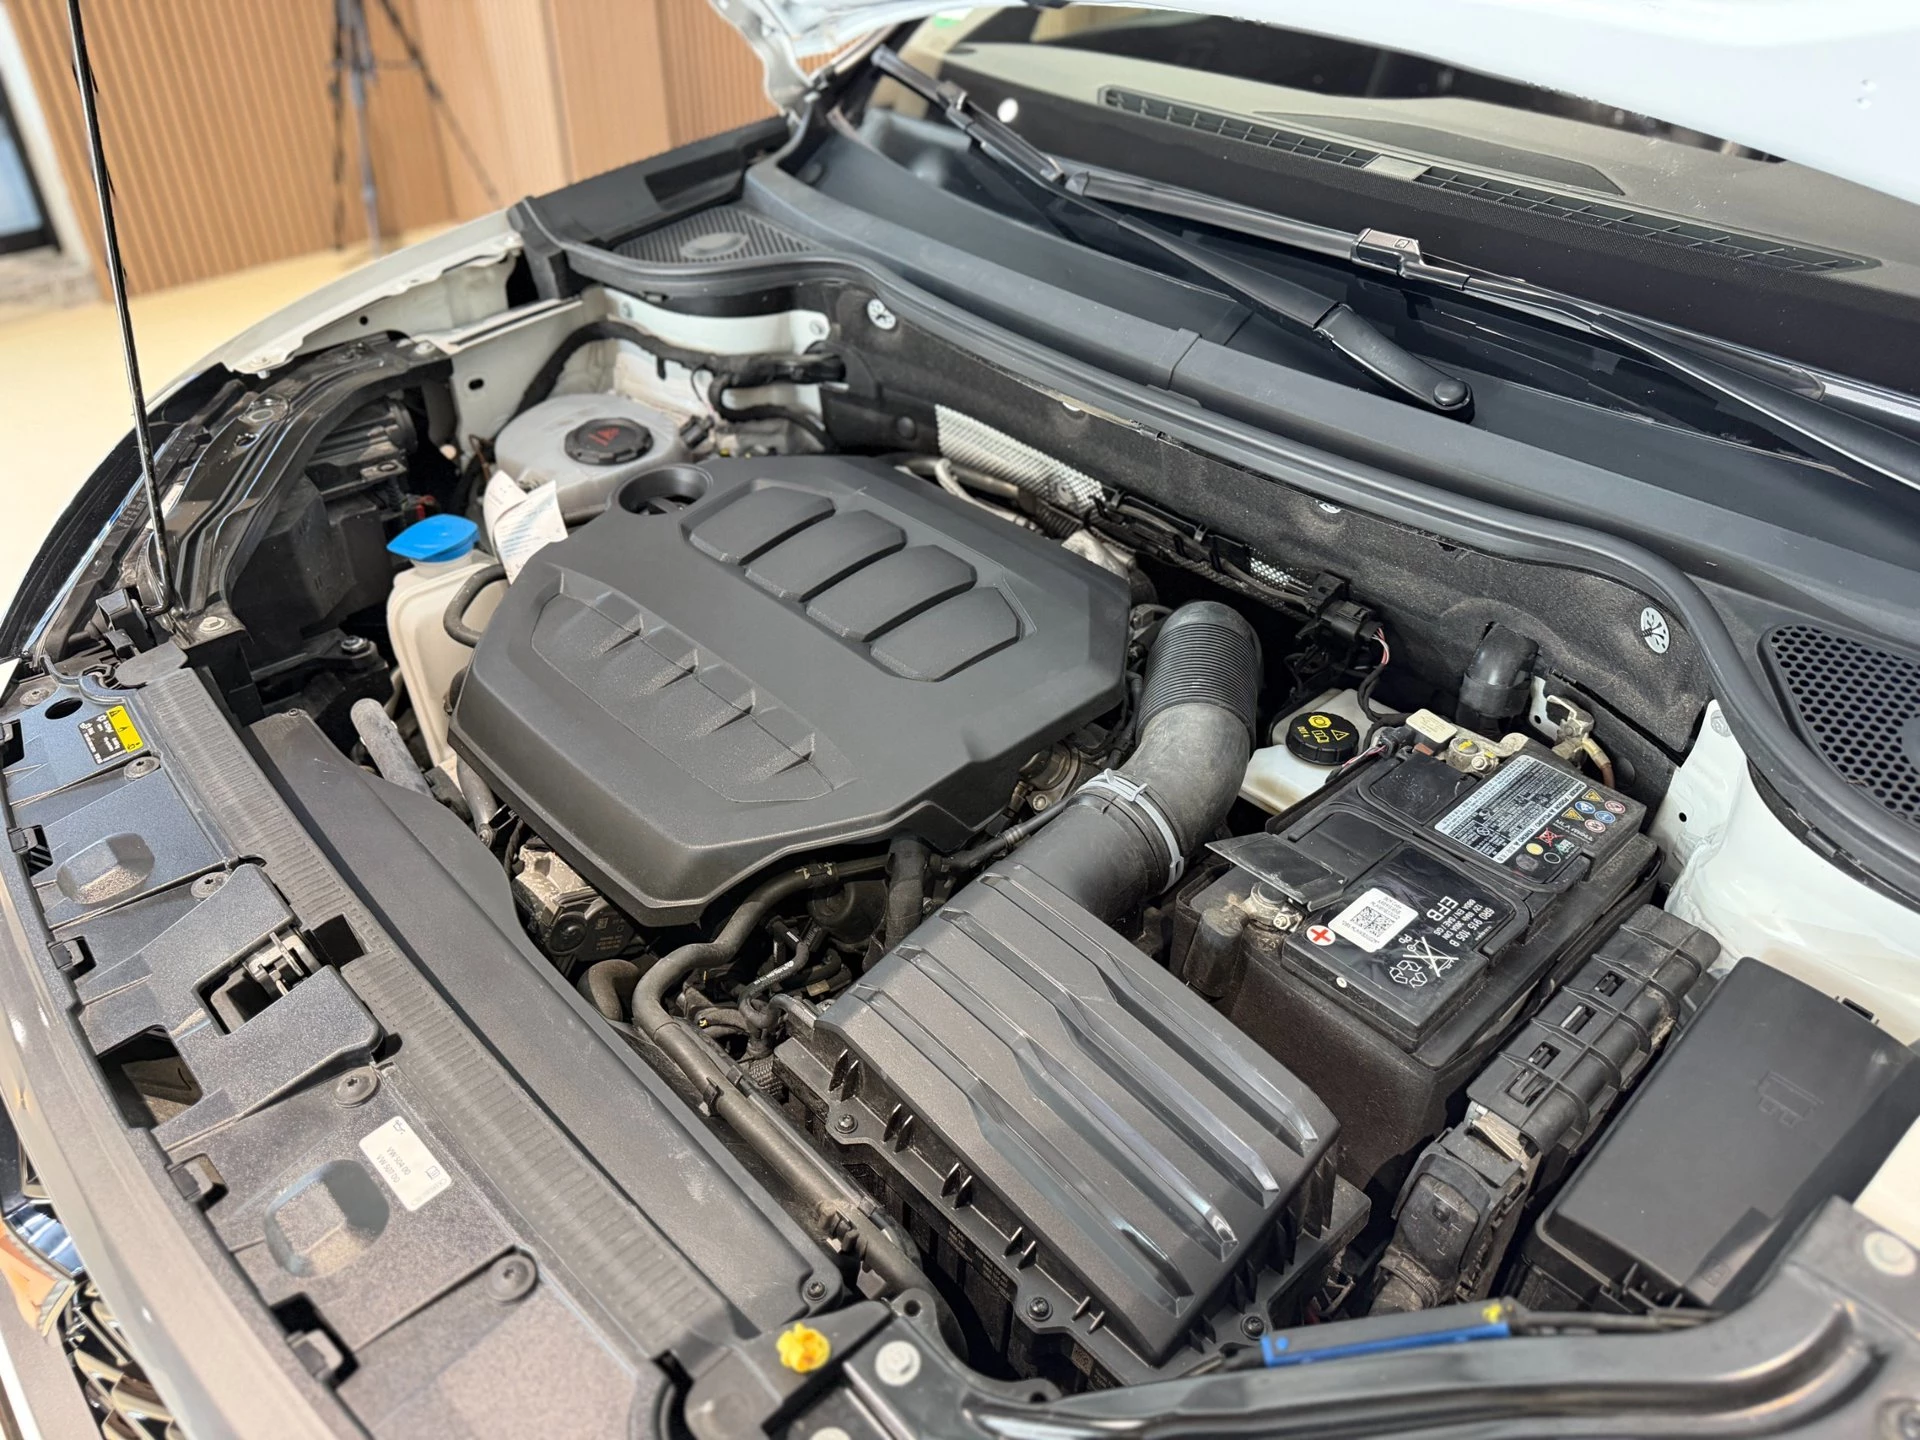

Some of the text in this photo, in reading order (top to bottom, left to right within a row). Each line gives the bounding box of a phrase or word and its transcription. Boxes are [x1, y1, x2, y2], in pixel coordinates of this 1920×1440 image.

[1426, 896, 1459, 921] EFB
[1467, 918, 1483, 931] 915
[1448, 939, 1460, 947] B
[1455, 929, 1471, 942] 105
[376, 1153, 387, 1165] VW
[390, 1172, 401, 1183] 00
[386, 1146, 397, 1157] VW
[401, 1165, 412, 1176] 00
